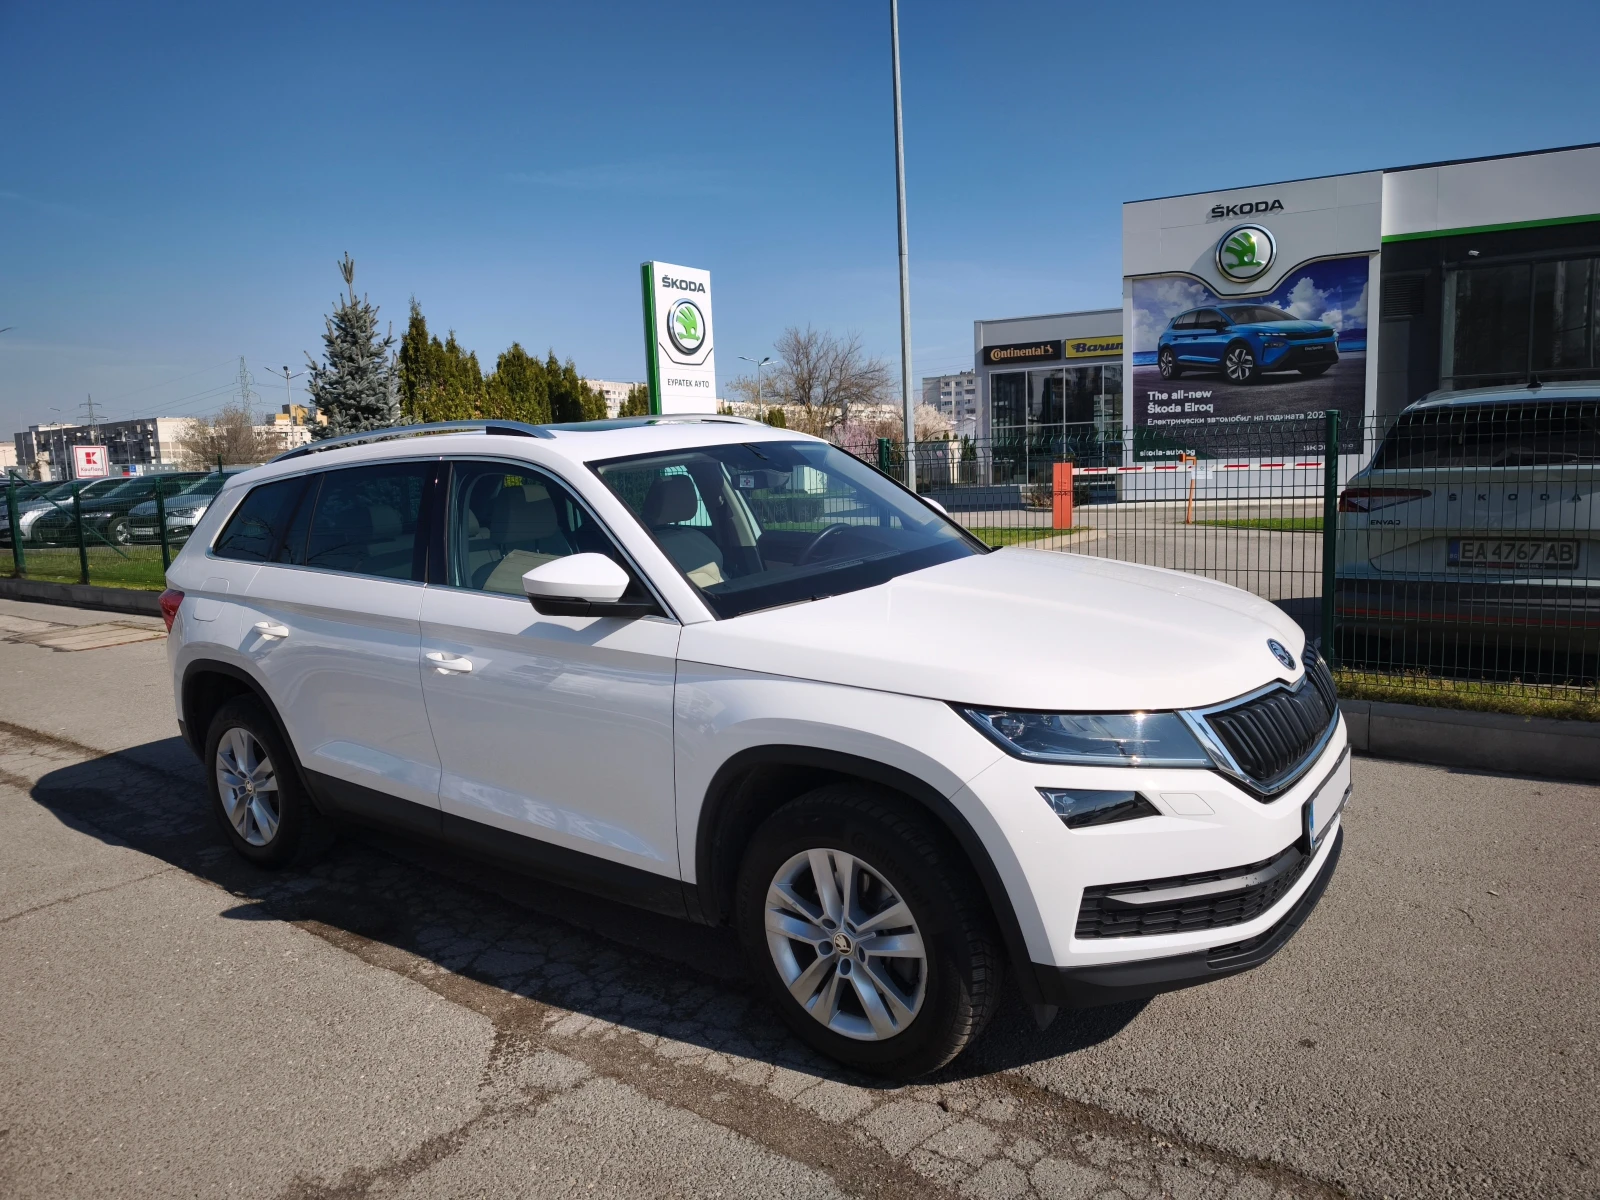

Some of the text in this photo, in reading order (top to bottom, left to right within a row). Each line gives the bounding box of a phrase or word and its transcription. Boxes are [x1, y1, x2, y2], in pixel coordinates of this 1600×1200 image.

[1211, 199, 1284, 218] ŠKODA
[661, 274, 706, 293] ŠKODA
[990, 345, 1045, 361] Continental
[1147, 390, 1213, 400] The all-new
[1147, 402, 1214, 414] Škoda Elroq
[1461, 542, 1574, 562] EA 4767 AB
